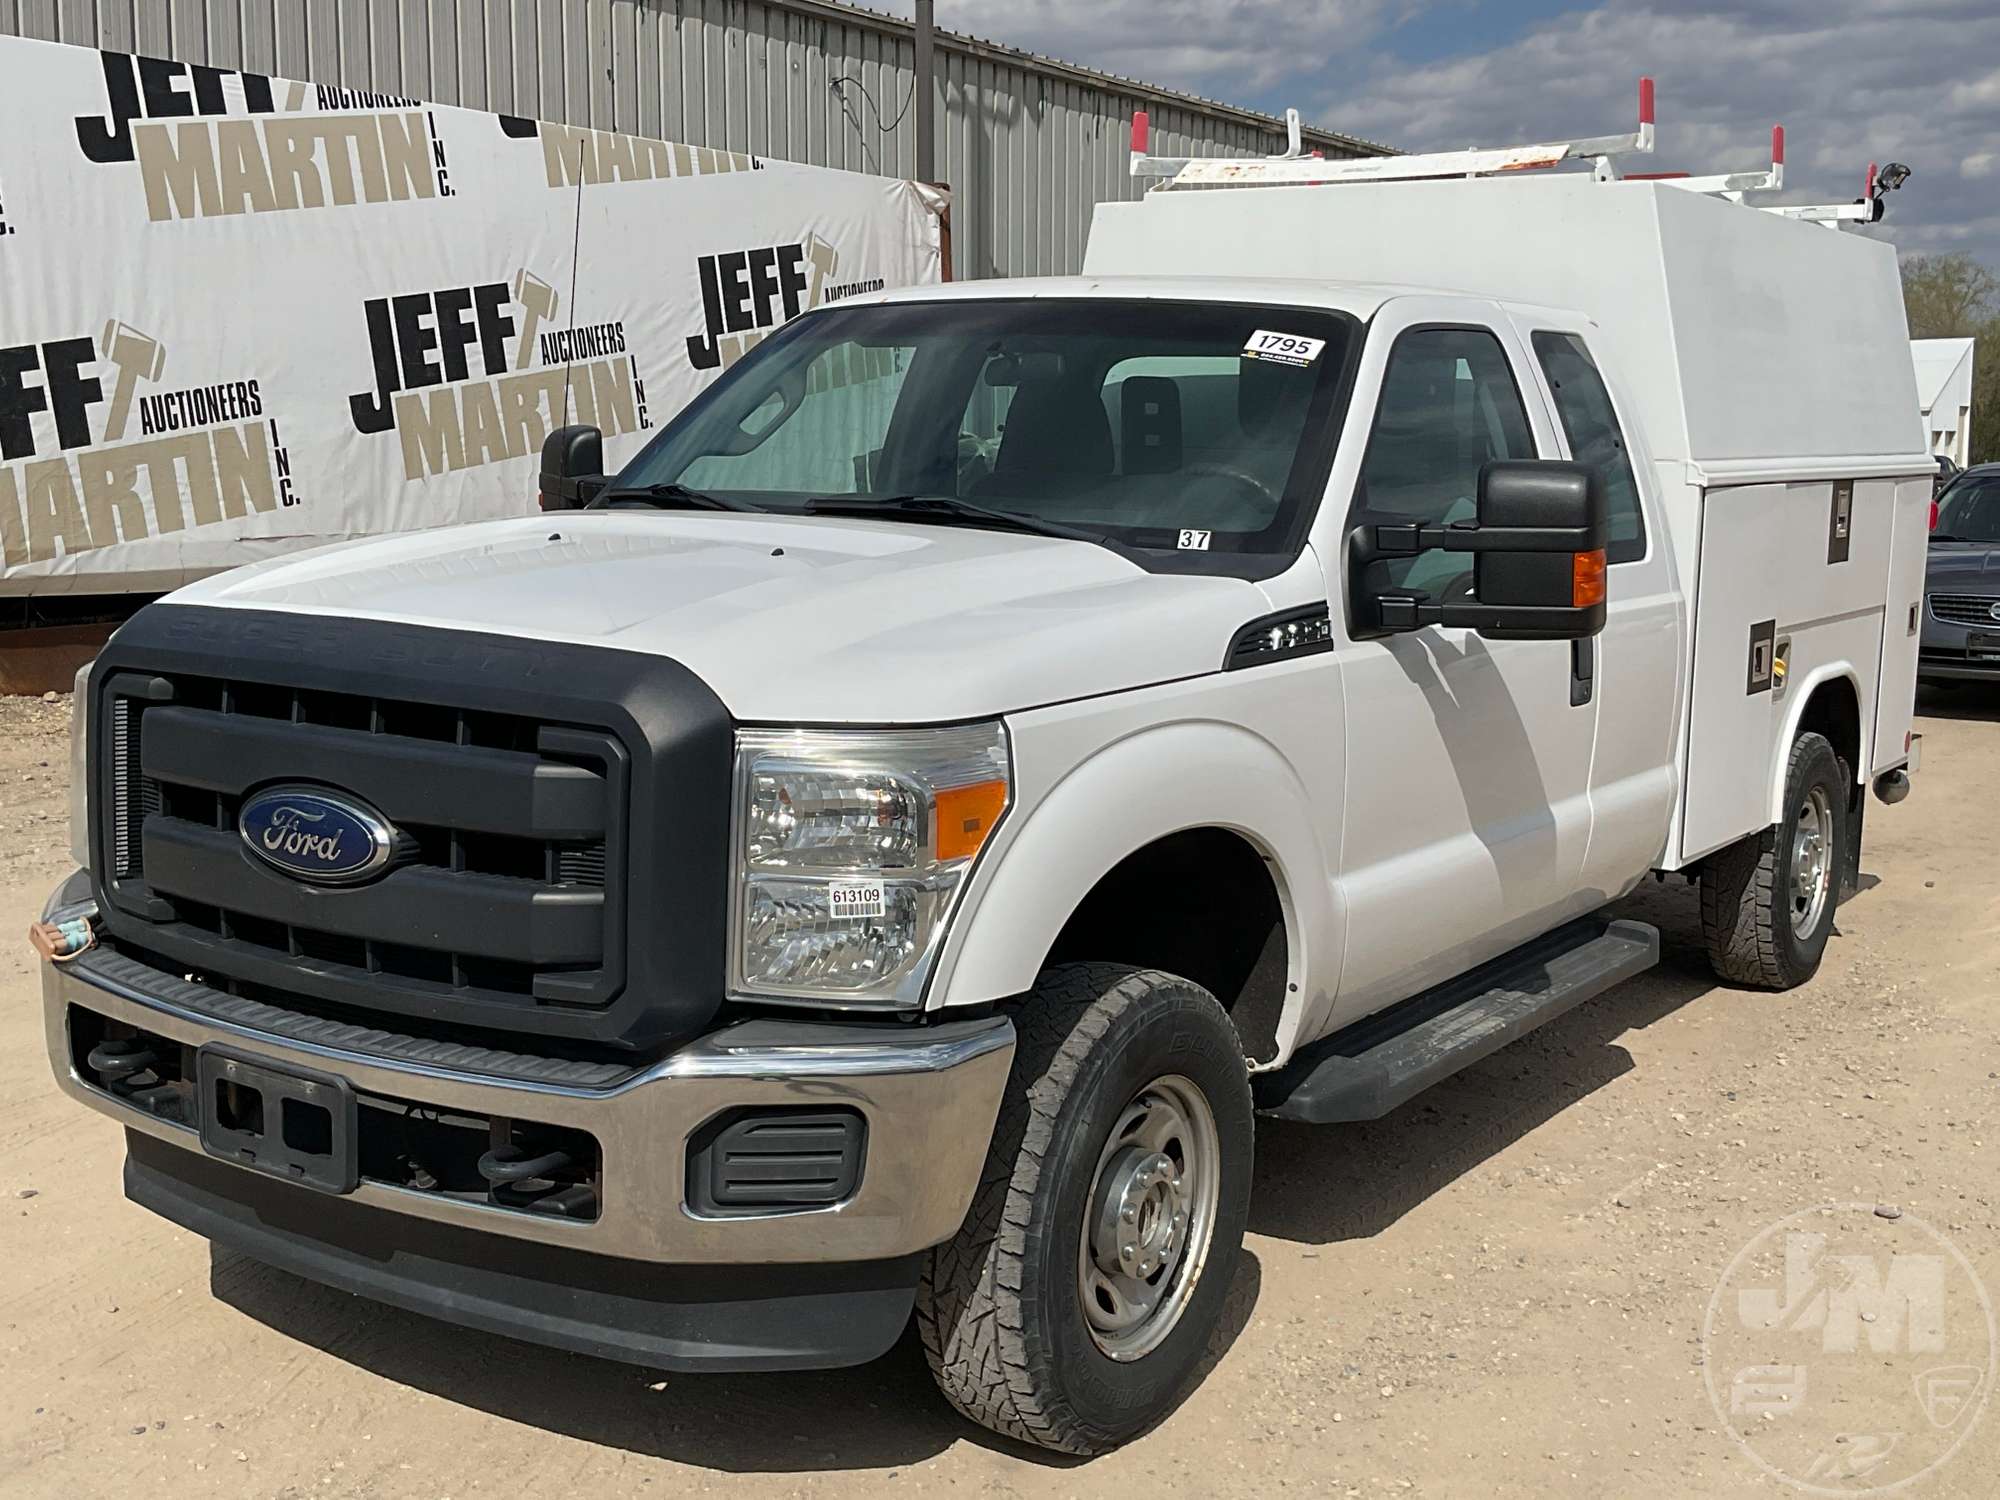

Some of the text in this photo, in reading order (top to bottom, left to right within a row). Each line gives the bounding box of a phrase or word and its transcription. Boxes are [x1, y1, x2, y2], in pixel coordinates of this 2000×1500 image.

[134, 113, 435, 222] MARTIN
[686, 243, 806, 370] JEFF
[349, 282, 515, 434] JEFF
[541, 321, 626, 365] AUCTIONEERS
[1259, 335, 1312, 354] 1795
[139, 379, 263, 435] AUCTIONEERS
[395, 357, 637, 480] MARTIN
[1181, 531, 1208, 548] 37
[264, 807, 344, 861] Ford
[833, 889, 880, 903] 613109
